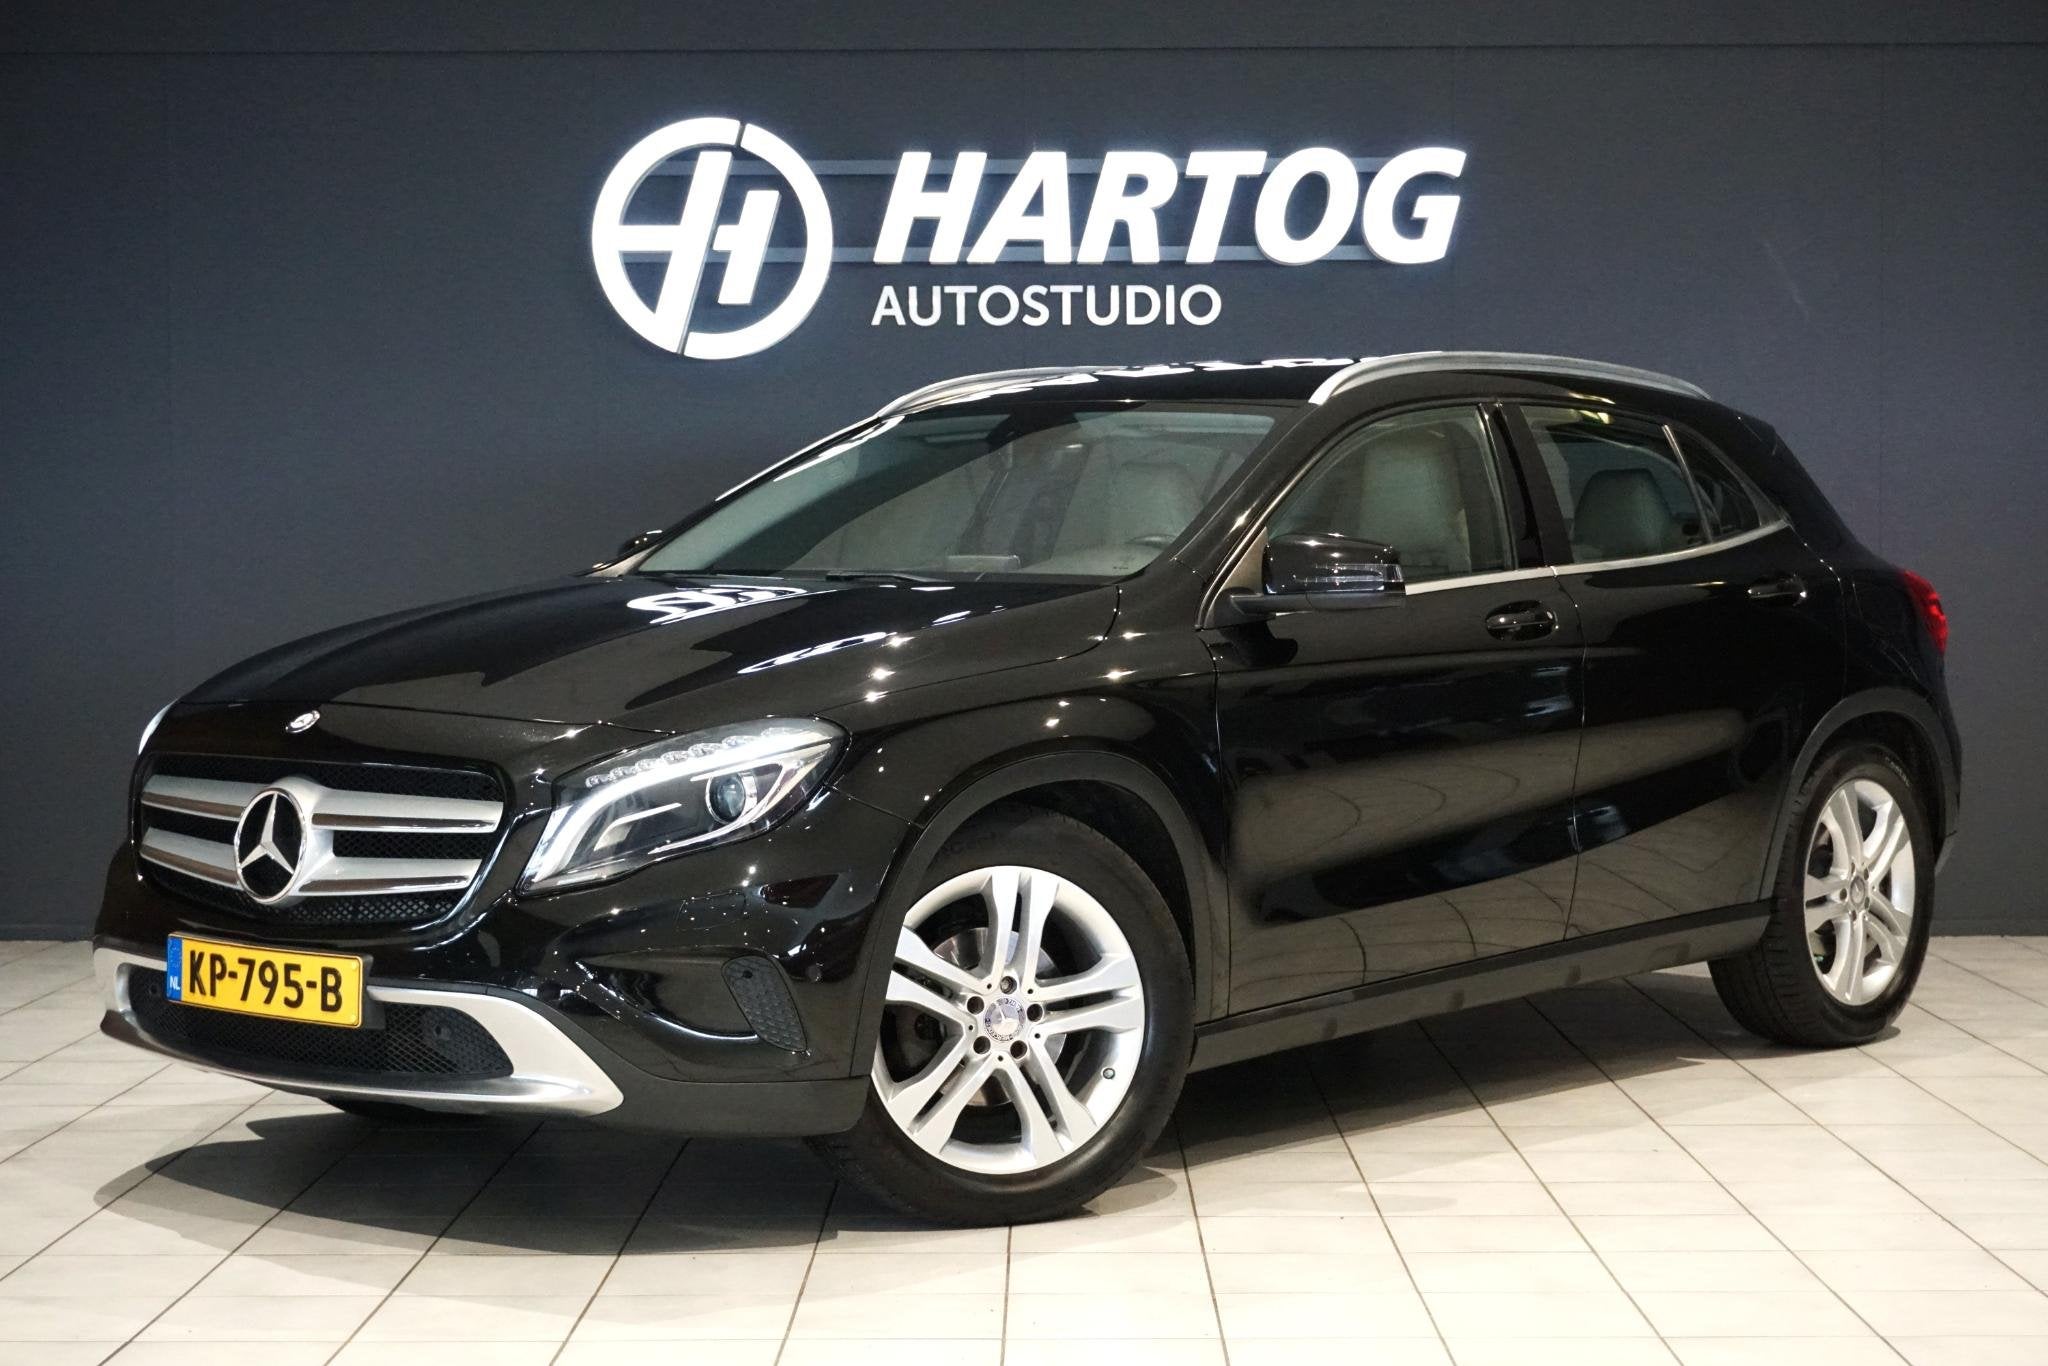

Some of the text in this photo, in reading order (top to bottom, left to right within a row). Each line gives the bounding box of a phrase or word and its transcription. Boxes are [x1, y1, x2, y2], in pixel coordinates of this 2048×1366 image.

[873, 146, 1467, 265] HARTOG
[870, 284, 1223, 327] AUTOSTUDIO
[169, 975, 181, 990] NL
[189, 949, 343, 1013] KP-795-B
